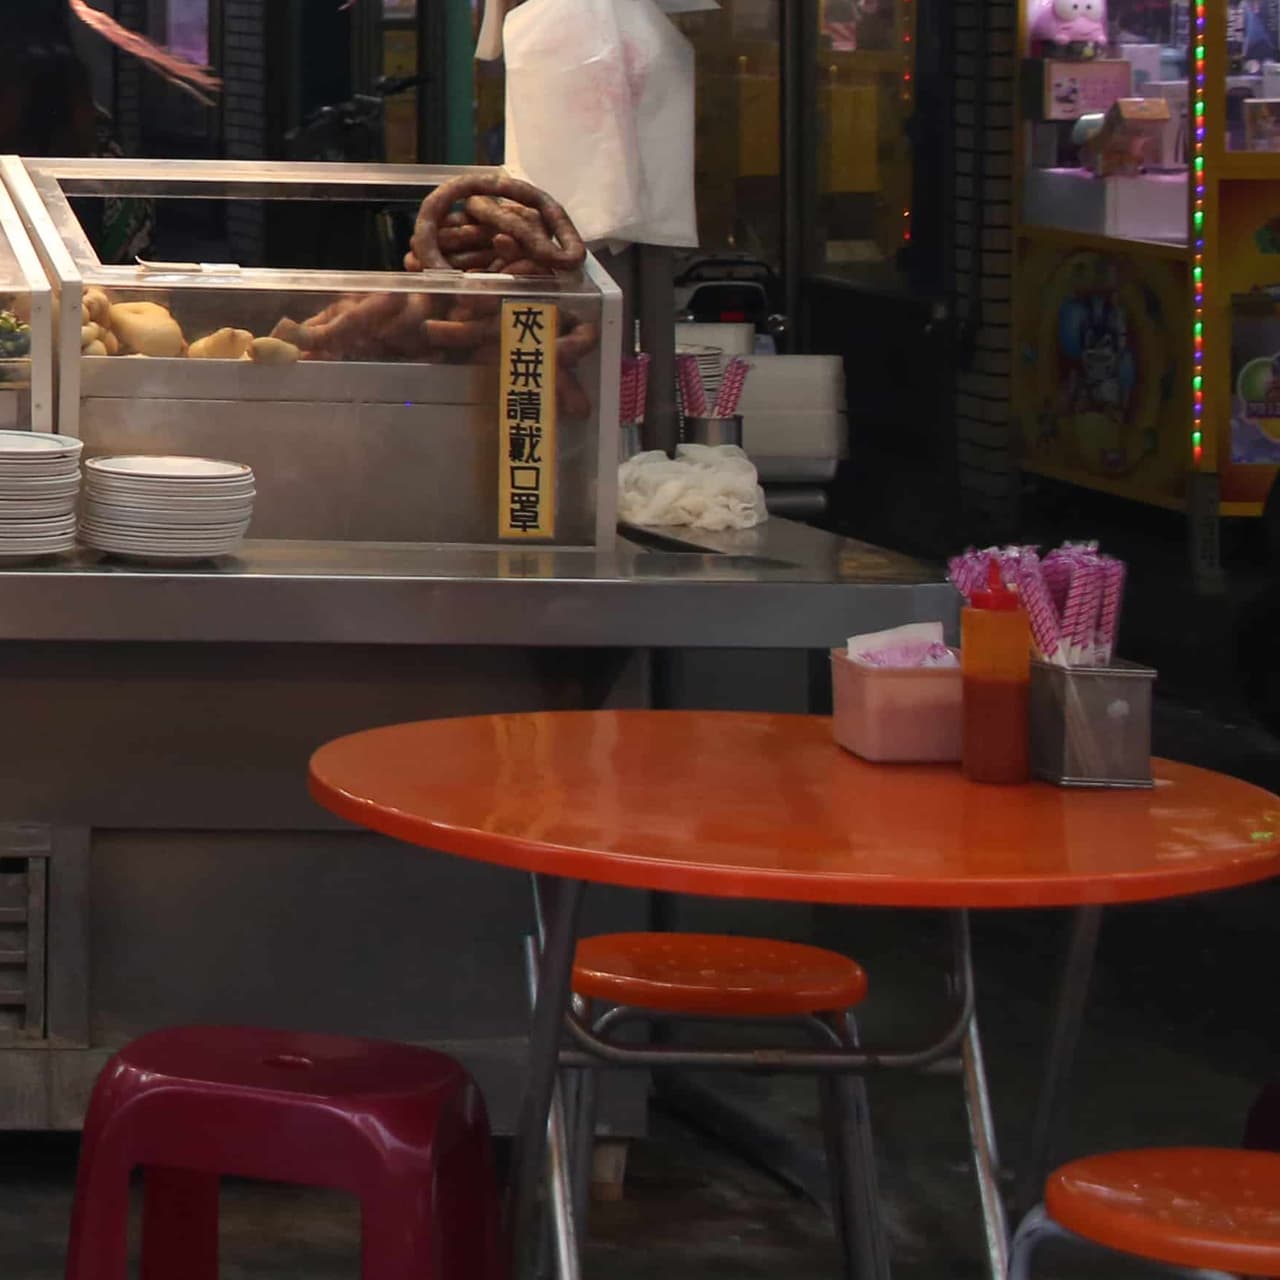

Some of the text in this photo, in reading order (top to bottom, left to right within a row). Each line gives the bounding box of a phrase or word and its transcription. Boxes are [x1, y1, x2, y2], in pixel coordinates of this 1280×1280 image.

[507, 307, 544, 532] 夾菜請戴口罩
